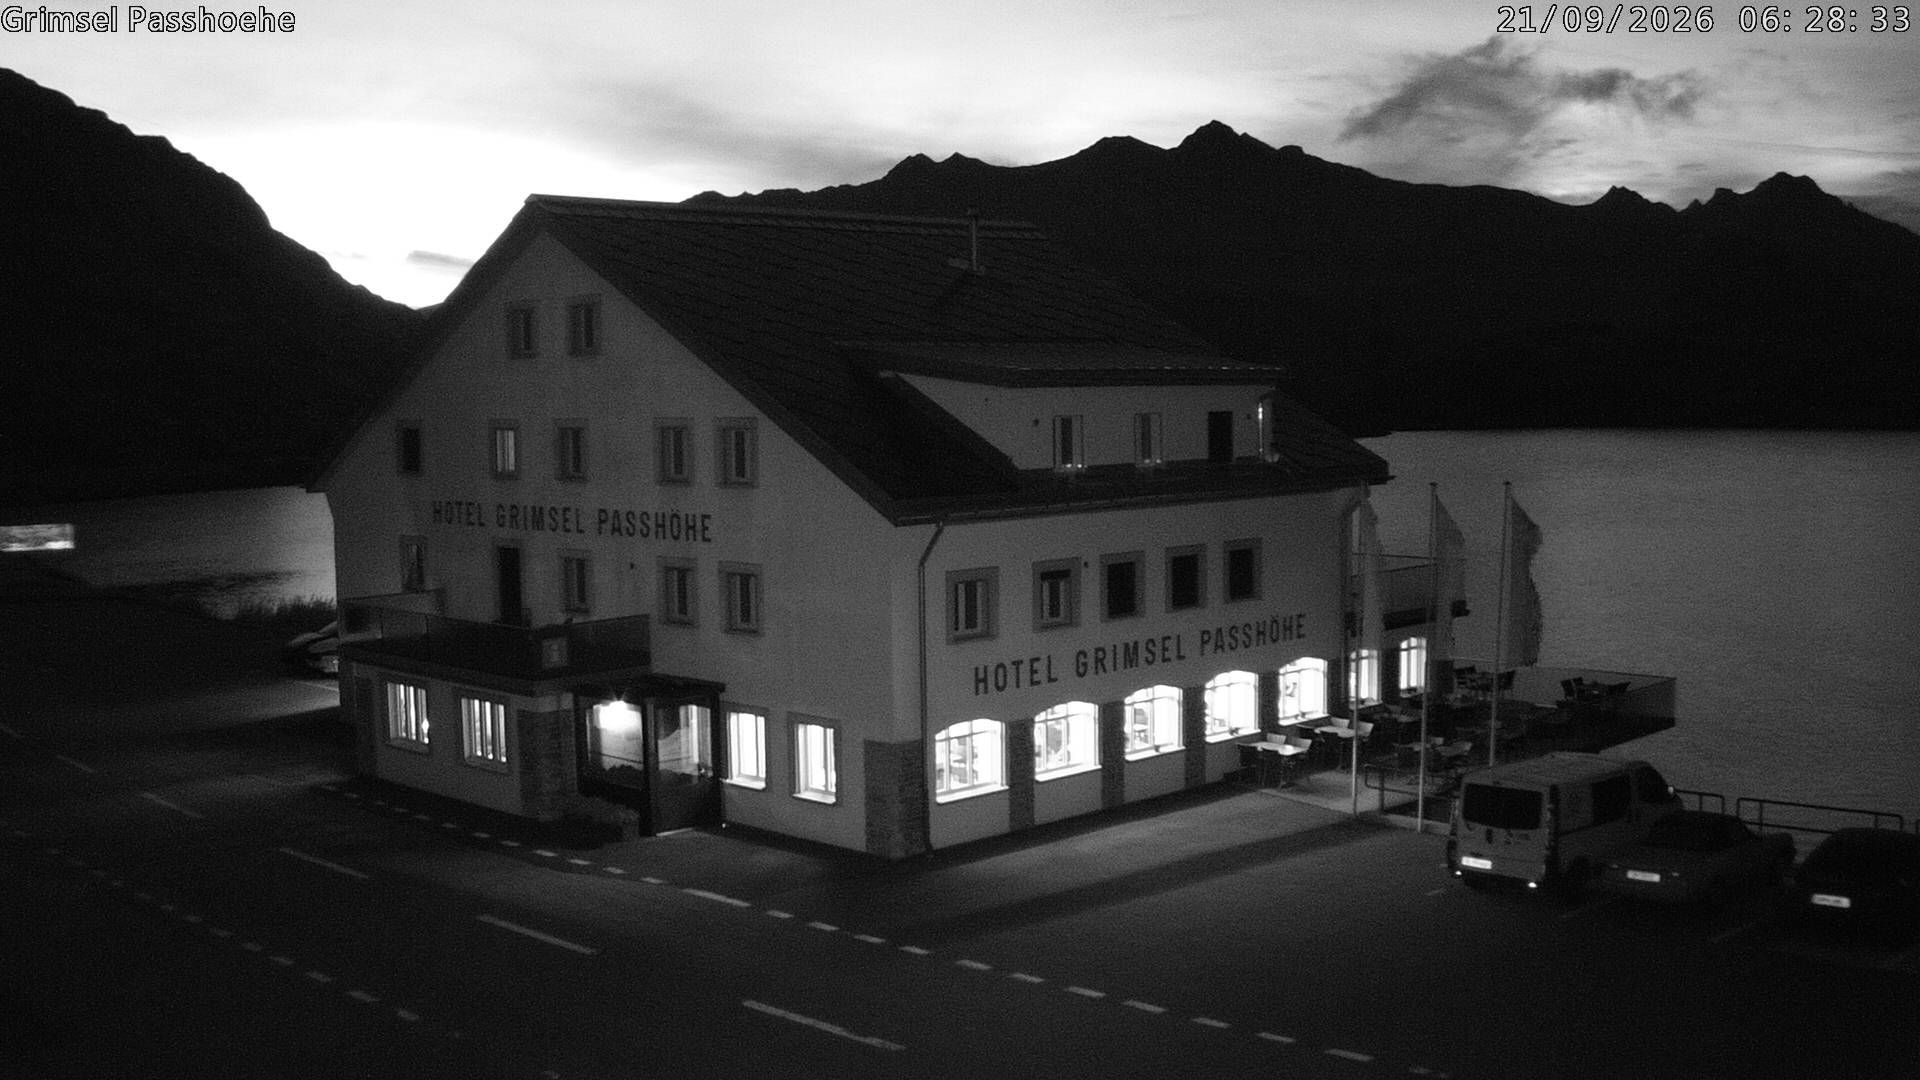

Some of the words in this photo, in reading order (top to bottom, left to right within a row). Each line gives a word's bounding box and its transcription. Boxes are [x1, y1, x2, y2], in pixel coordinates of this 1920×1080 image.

[432, 501, 485, 527] HOTEL
[495, 504, 586, 534] GRIMSEL
[597, 507, 712, 542] PASSHÖHE
[974, 655, 1058, 696] HOTEL
[1075, 636, 1186, 678] GRIMSEL
[1199, 613, 1307, 656] PASSHÖHE
